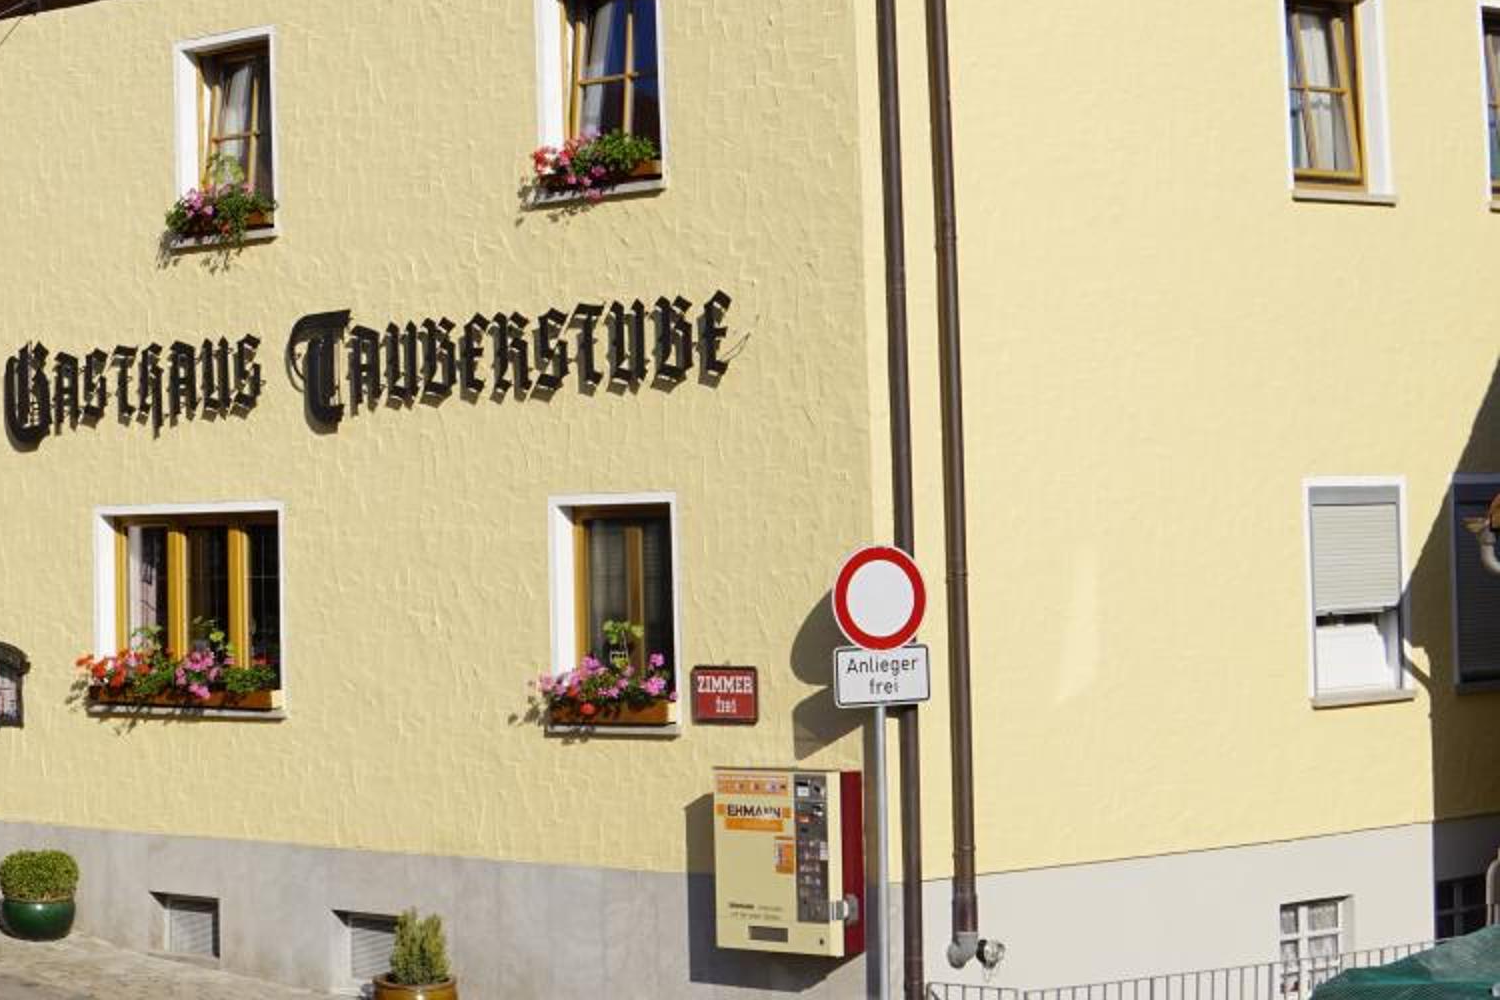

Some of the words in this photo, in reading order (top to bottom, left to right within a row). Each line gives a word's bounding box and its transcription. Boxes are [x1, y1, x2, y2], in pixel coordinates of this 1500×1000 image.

[846, 656, 918, 677] Anlieger
[696, 674, 754, 694] ZIMMER
[869, 678, 899, 695] frei
[715, 695, 737, 714] frei
